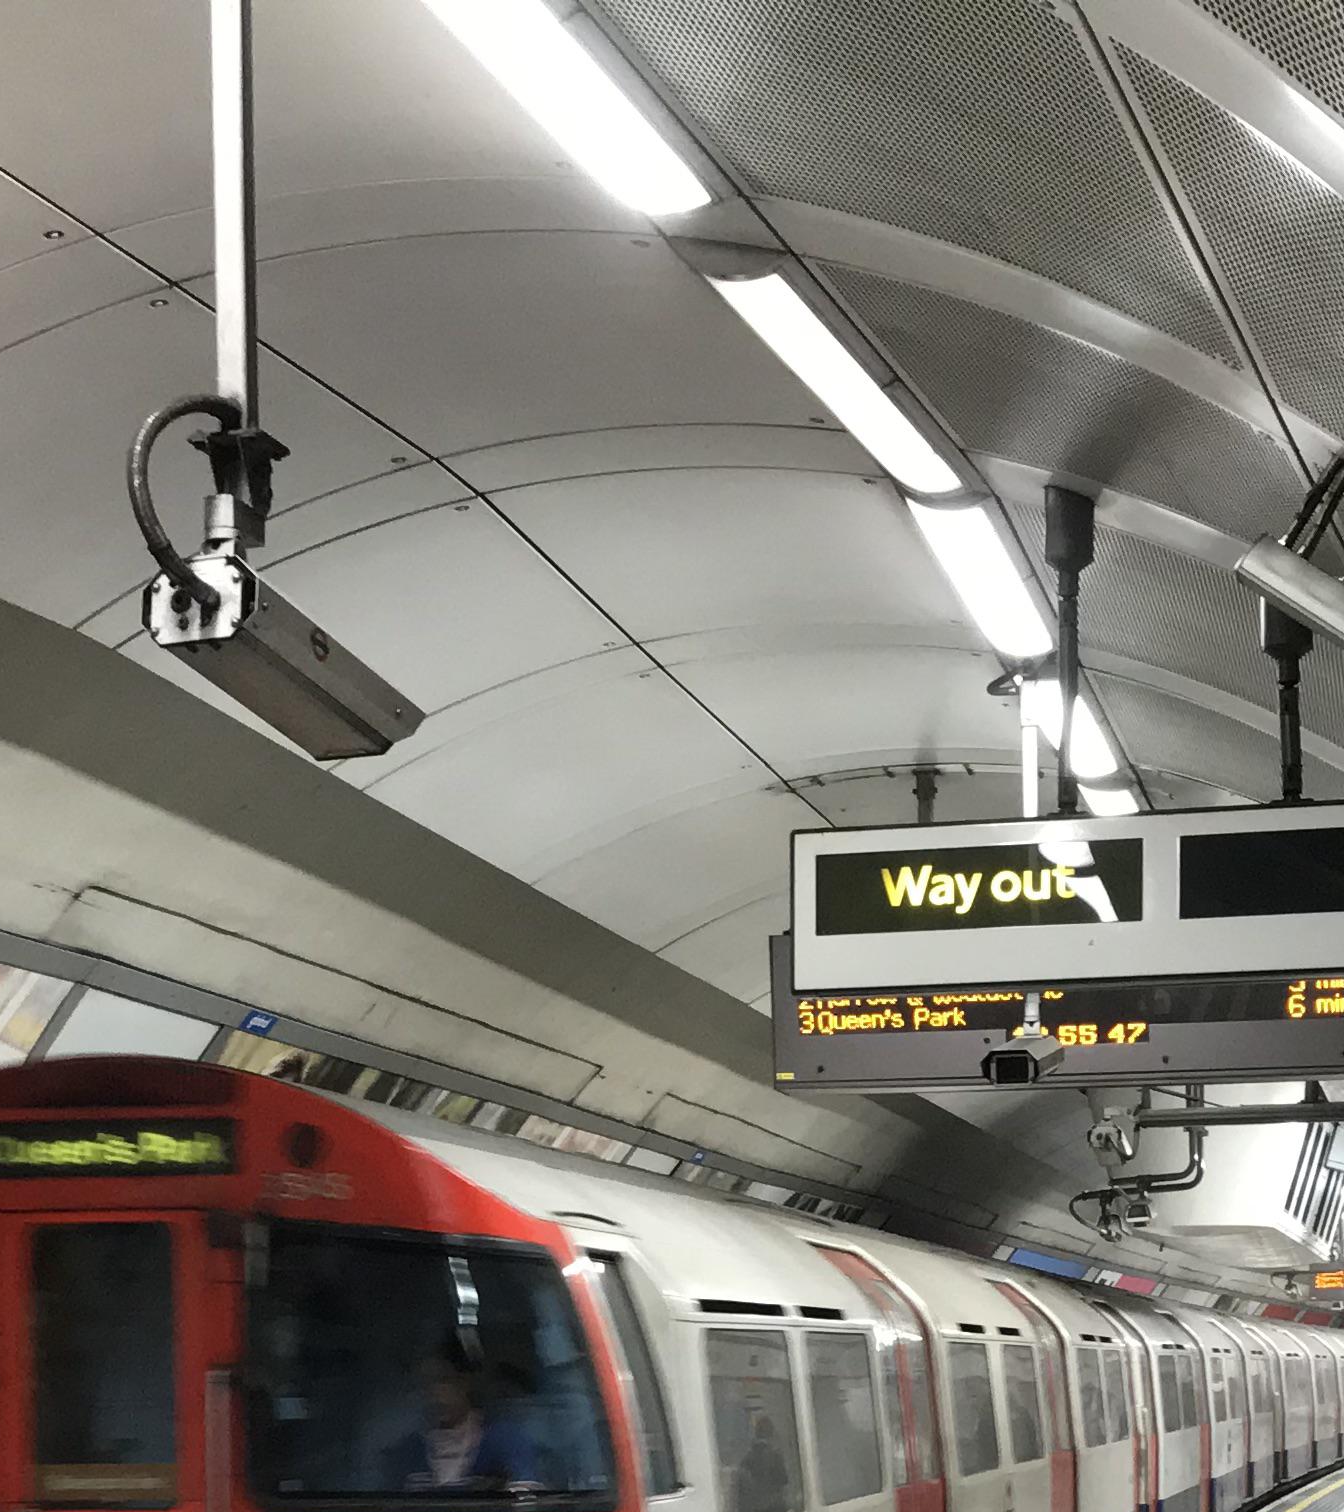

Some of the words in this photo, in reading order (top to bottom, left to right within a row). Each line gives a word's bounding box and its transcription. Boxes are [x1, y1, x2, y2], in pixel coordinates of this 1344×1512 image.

[882, 862, 984, 916] Way
[913, 1005, 968, 1031] Park
[1287, 993, 1307, 1019] 6
[1107, 1022, 1146, 1043] 47
